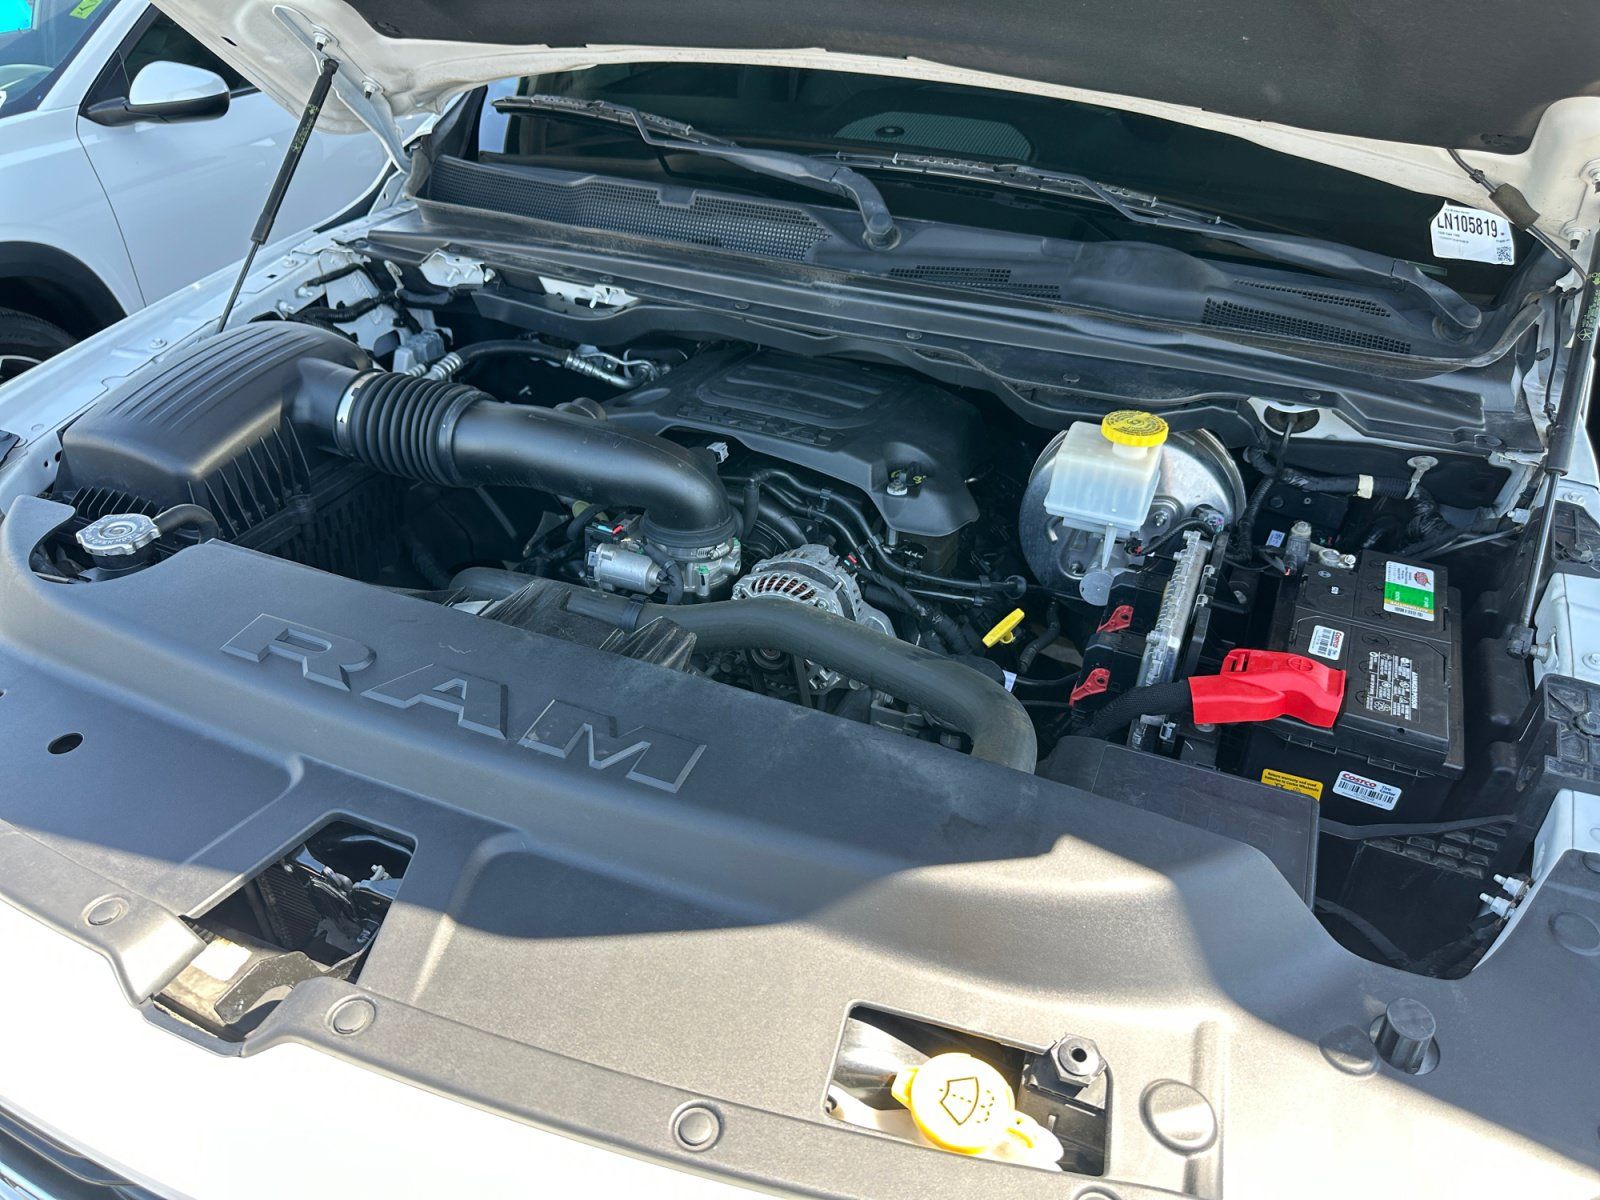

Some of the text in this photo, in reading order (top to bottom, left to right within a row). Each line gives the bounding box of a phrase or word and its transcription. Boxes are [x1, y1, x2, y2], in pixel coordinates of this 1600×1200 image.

[1437, 212, 1498, 238] LN105819
[220, 613, 708, 793] RAM
[1343, 773, 1377, 787] COSTCO
